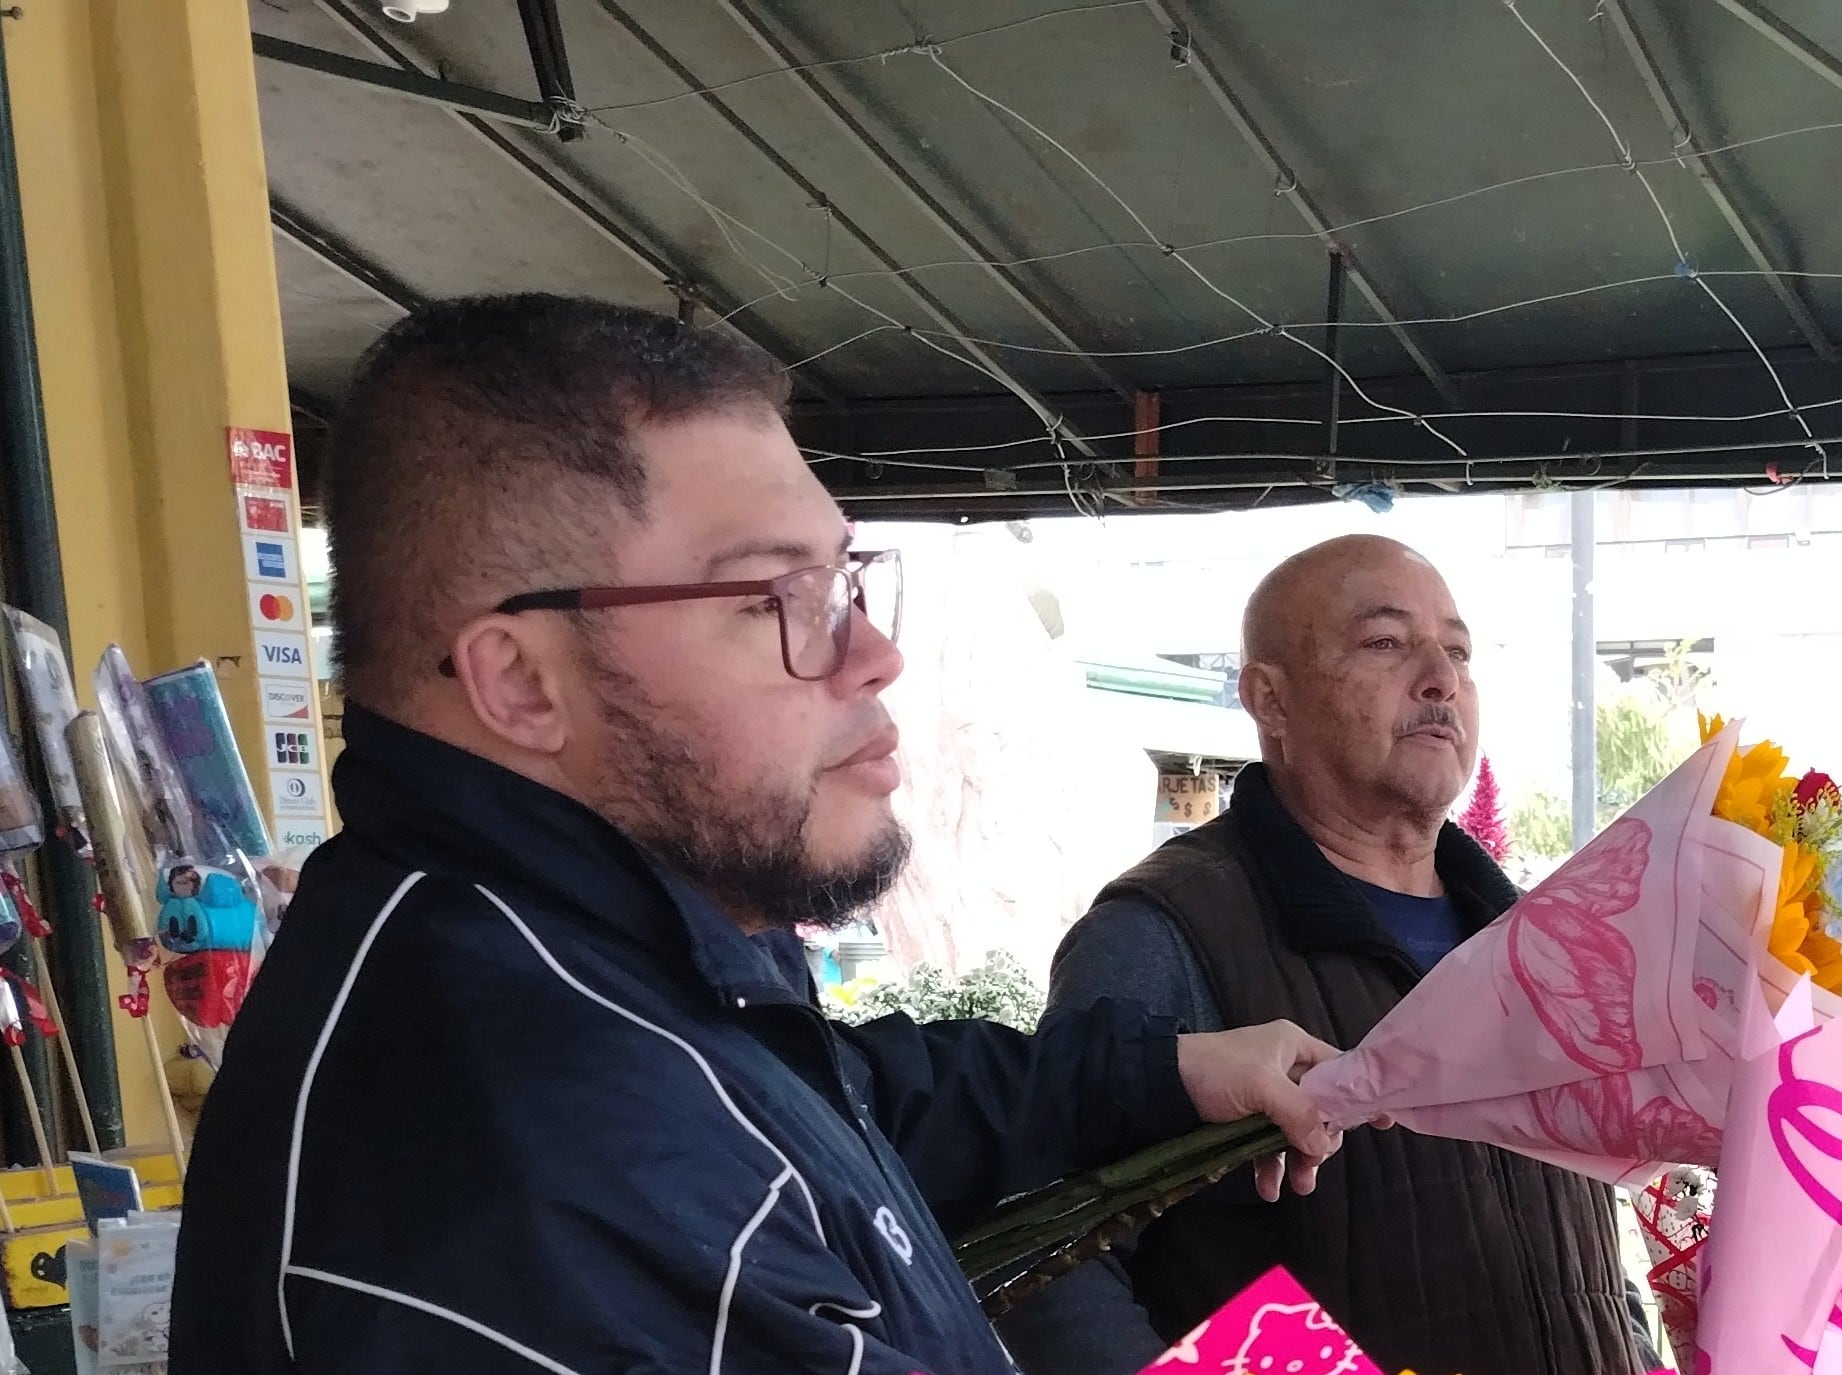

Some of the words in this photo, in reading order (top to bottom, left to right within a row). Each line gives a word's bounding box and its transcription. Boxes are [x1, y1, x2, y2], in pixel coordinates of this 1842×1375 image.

[250, 441, 287, 462] BAC
[261, 645, 303, 664] VISA
[268, 692, 305, 702] DISCOVER
[1160, 776, 1216, 794] RJETAS
